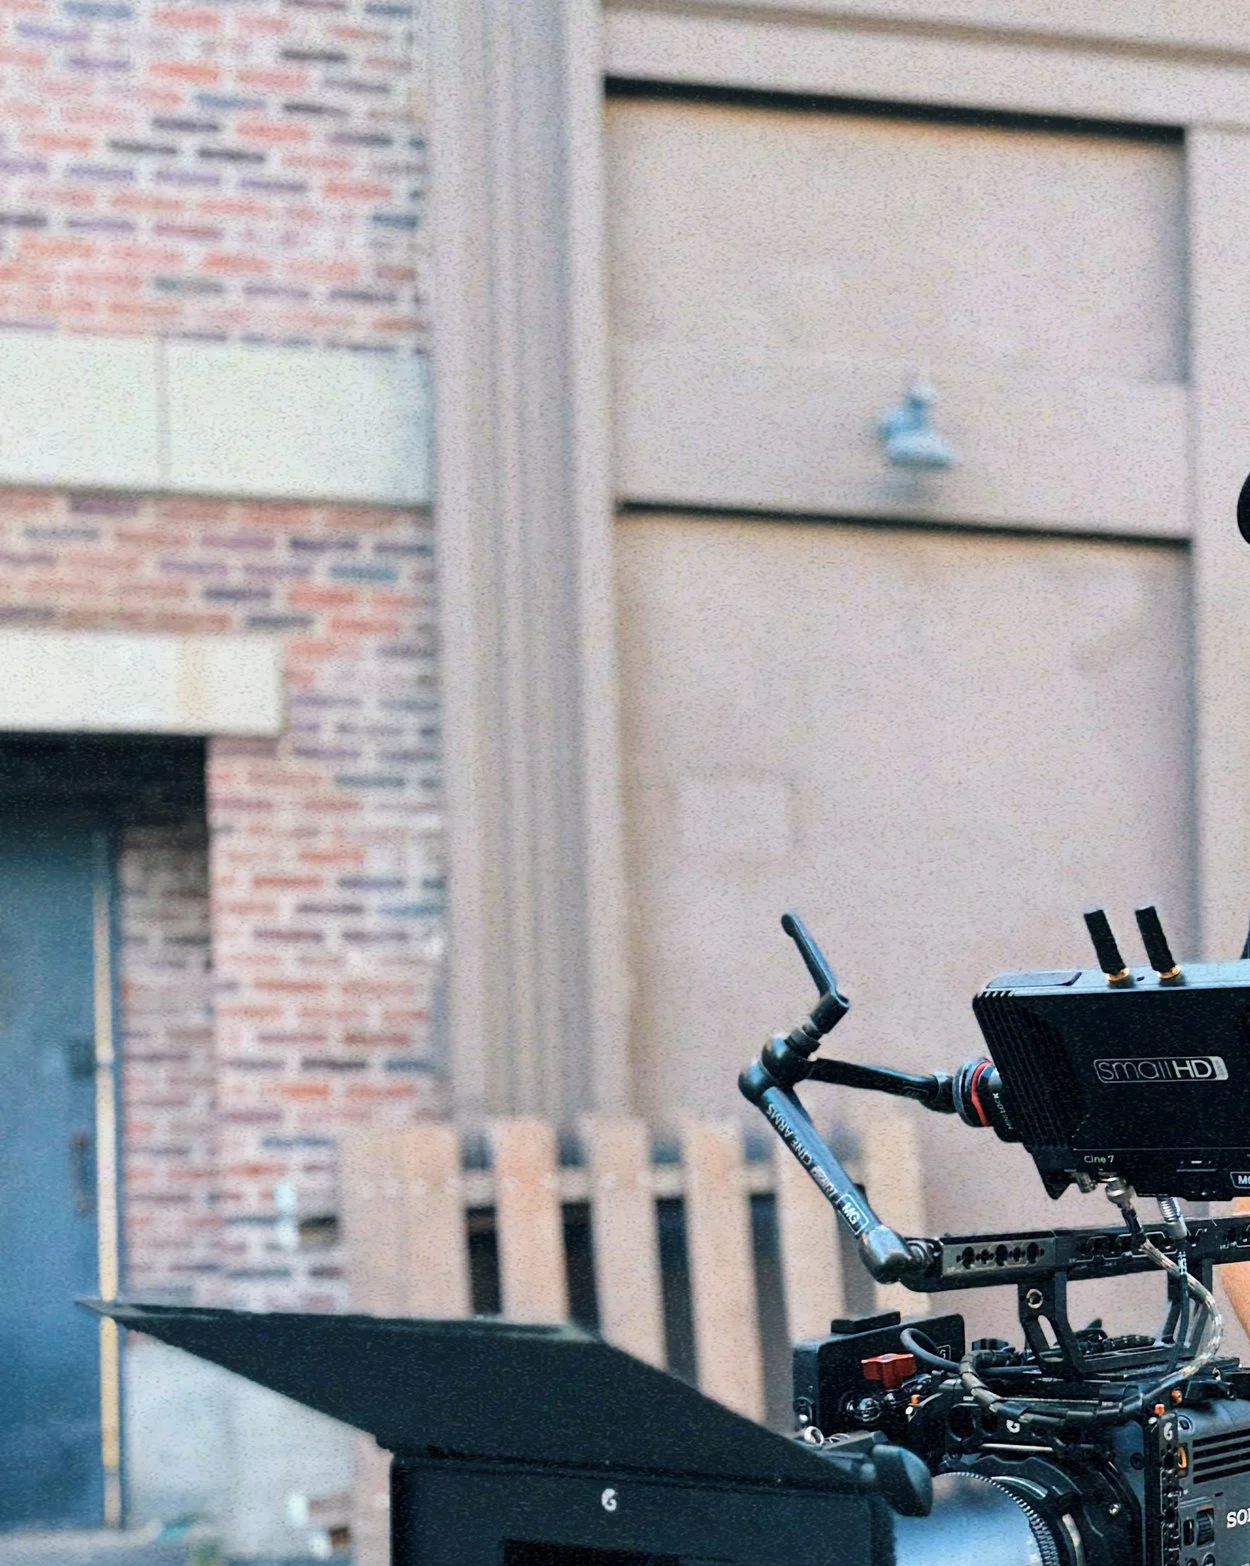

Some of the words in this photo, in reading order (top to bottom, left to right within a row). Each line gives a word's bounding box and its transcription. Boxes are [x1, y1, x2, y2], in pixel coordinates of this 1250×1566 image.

[1098, 1060, 1212, 1081] smallHD
[766, 1103, 793, 1138] ARMS
[790, 1138, 813, 1166] CINE
[1083, 1155, 1107, 1164] Cine
[1107, 1155, 1114, 1163] 7
[841, 1201, 861, 1226] MG
